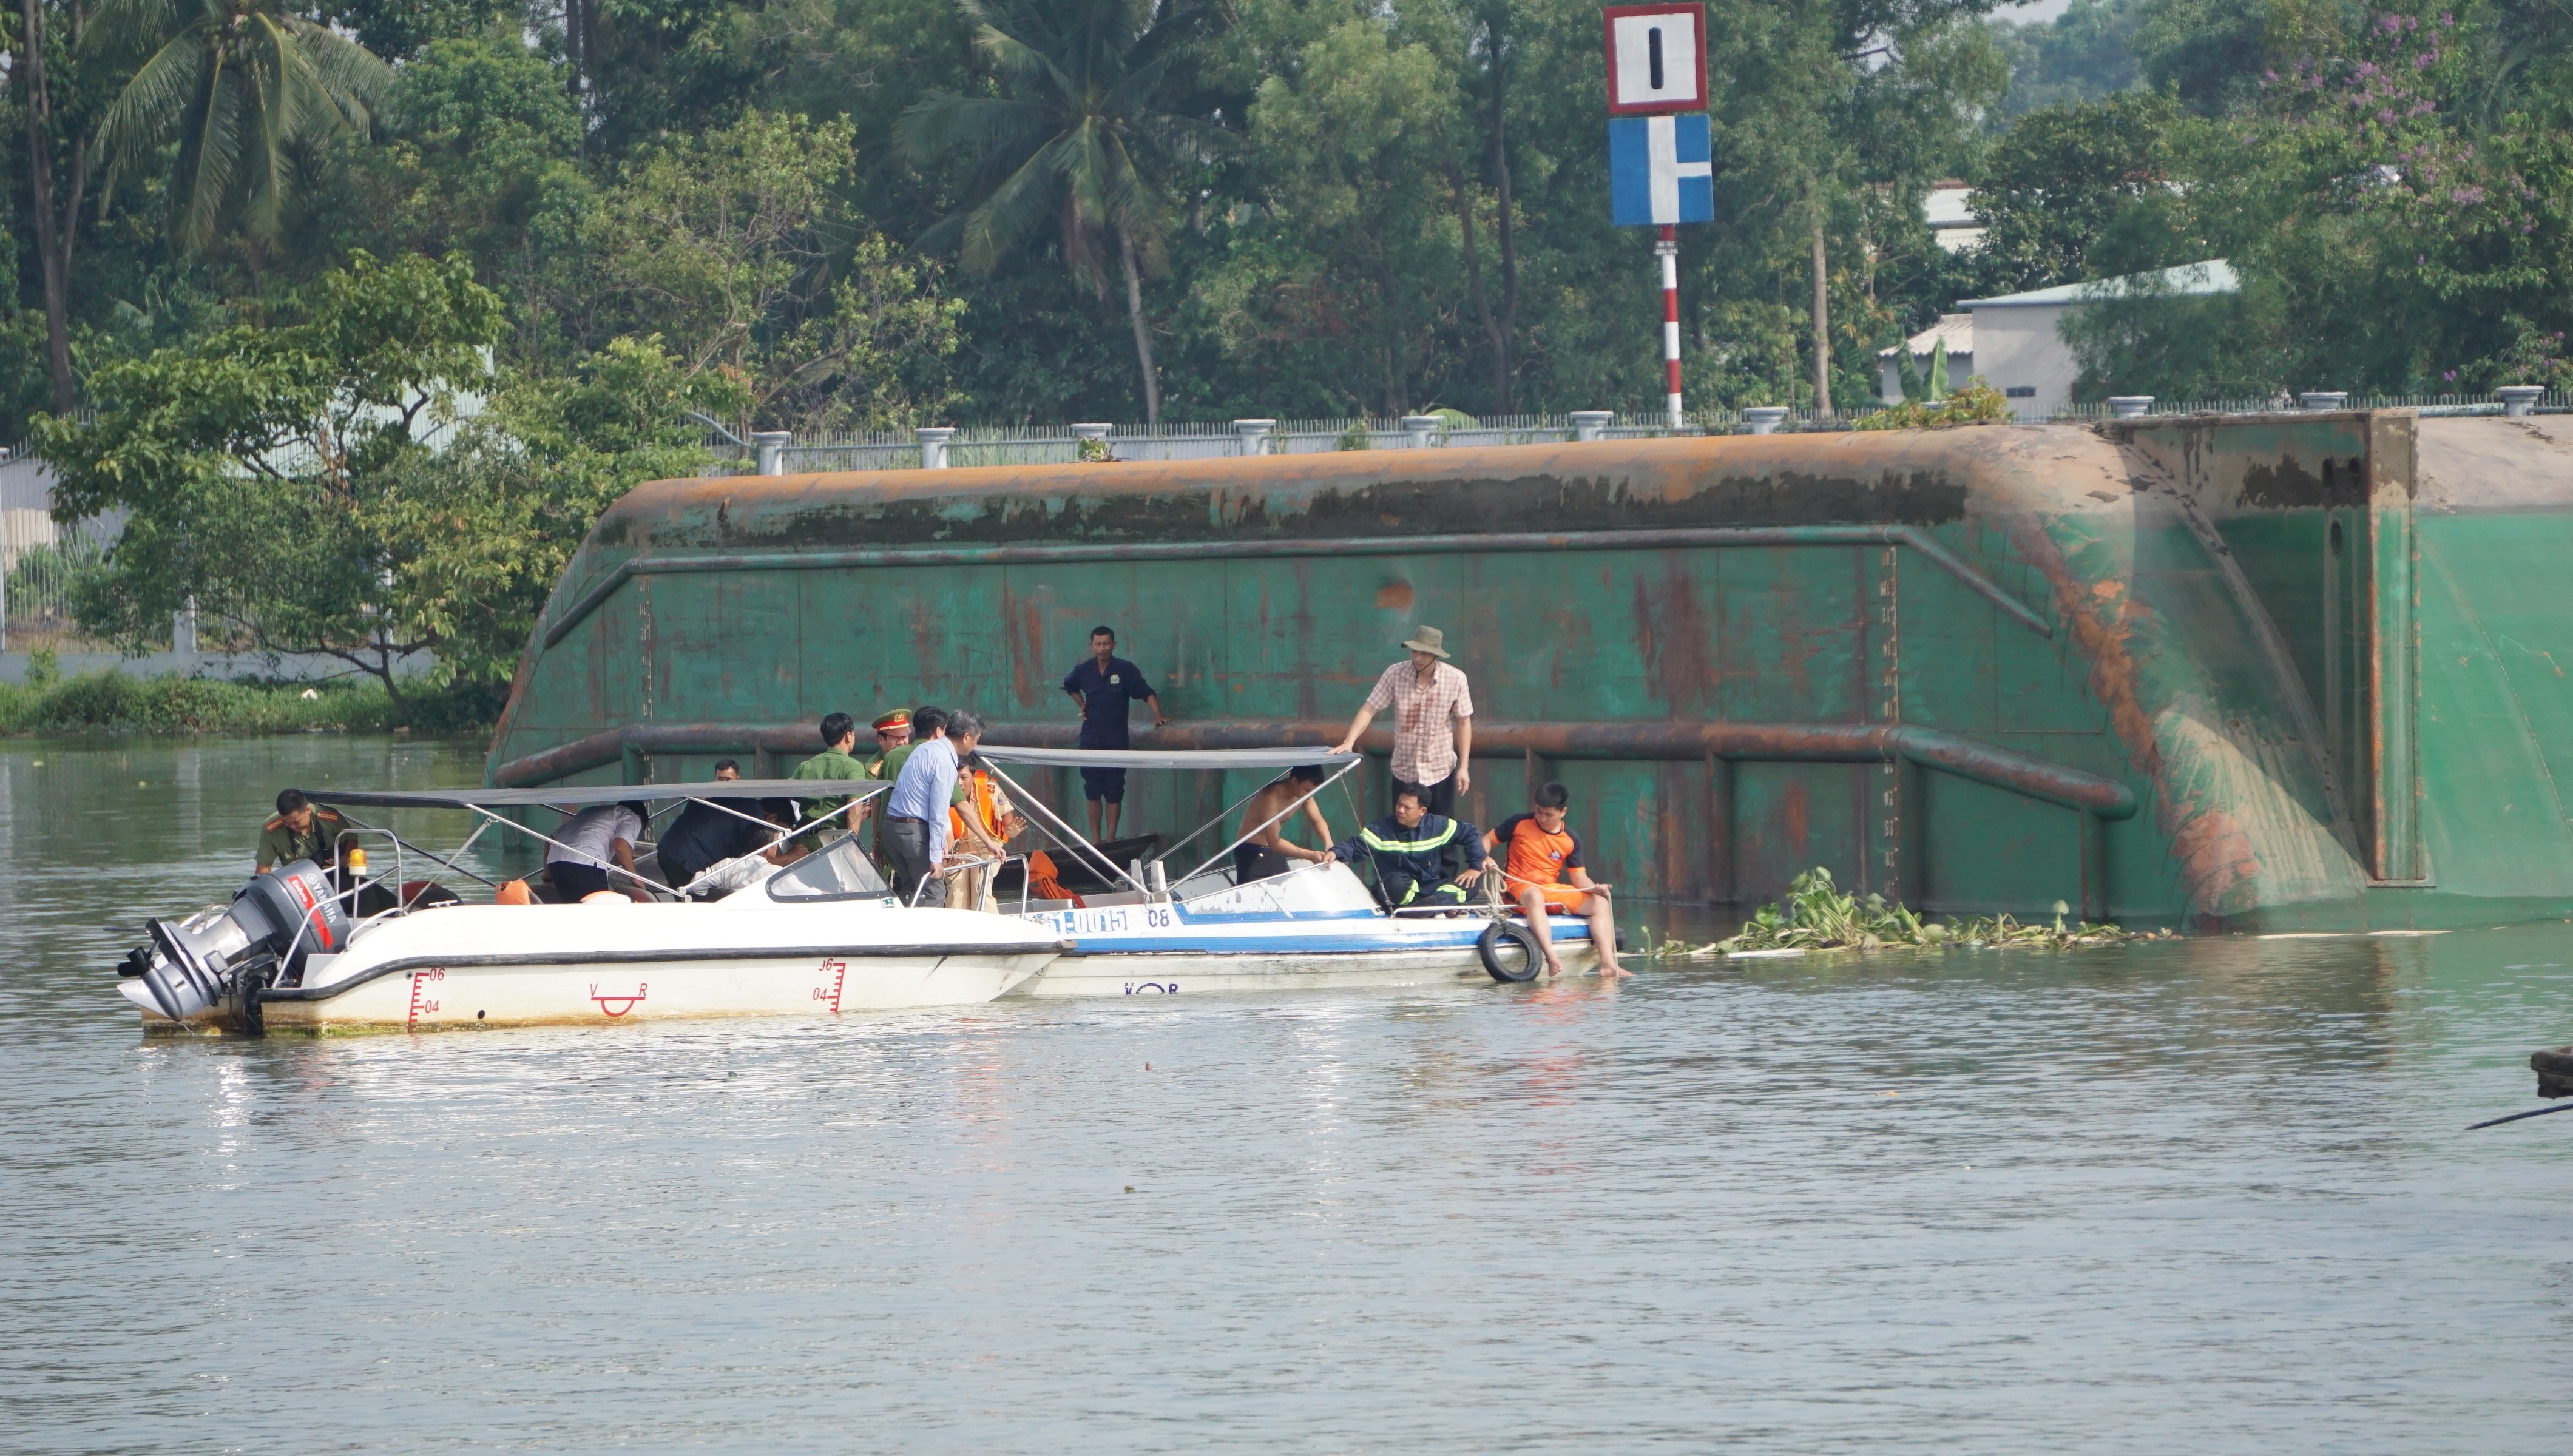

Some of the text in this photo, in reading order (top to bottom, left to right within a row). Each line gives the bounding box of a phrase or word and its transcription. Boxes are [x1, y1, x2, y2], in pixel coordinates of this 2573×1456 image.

[292, 880, 308, 902] Enduro
[1148, 909, 1170, 928] 08
[430, 966, 445, 981] 06
[590, 983, 648, 997] V R
[813, 987, 827, 1002] 04
[425, 1000, 439, 1014] 04
